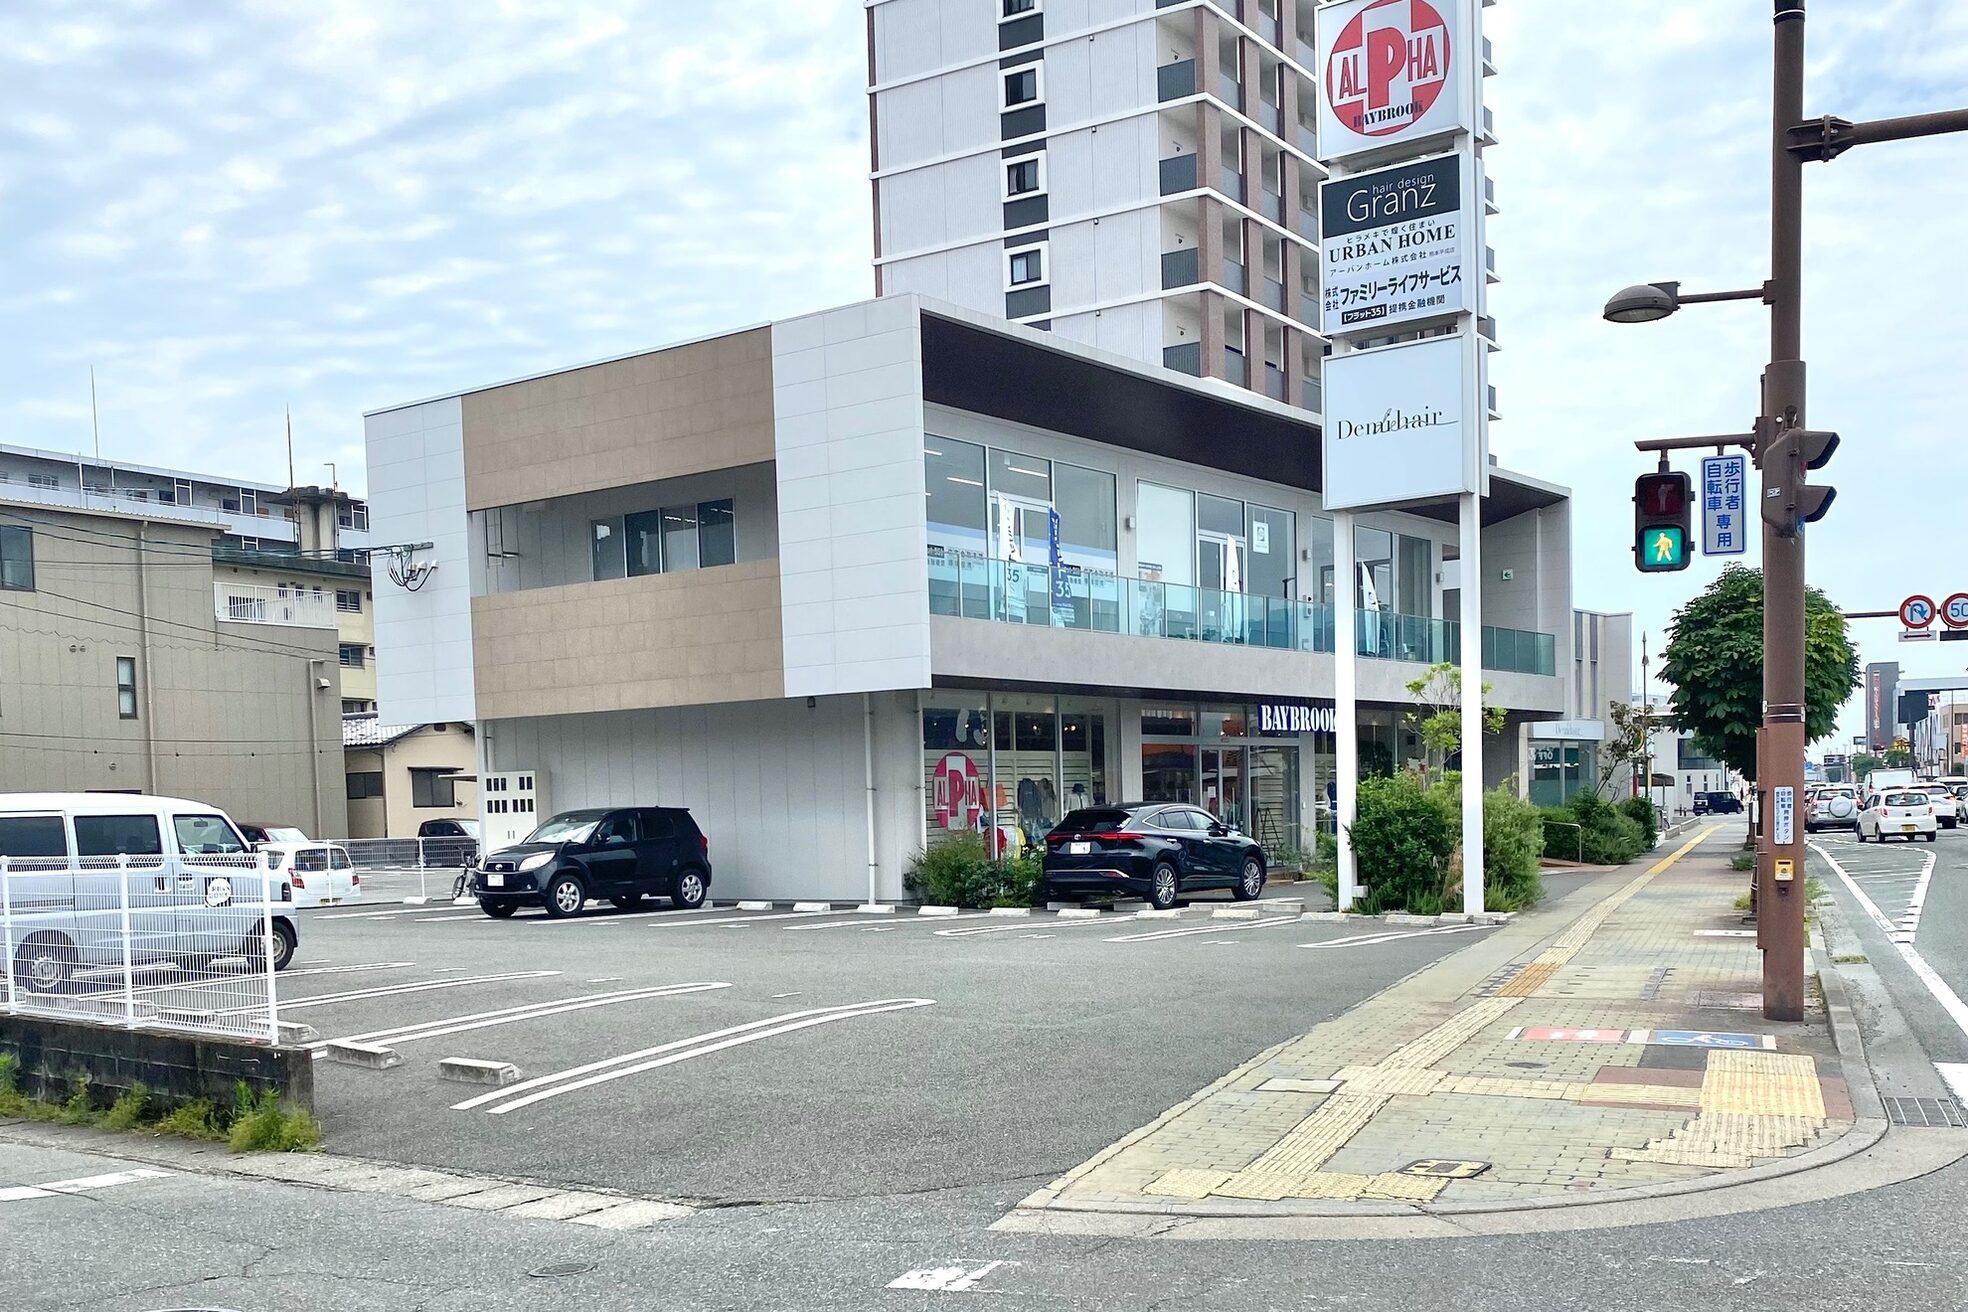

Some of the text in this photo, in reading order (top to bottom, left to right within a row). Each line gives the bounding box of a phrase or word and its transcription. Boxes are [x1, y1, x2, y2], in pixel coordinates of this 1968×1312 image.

[1339, 27, 1438, 110] ALPHA
[1353, 100, 1423, 128] BAYBROOK
[1347, 183, 1436, 222] Granz
[1373, 173, 1434, 195] hair design
[1329, 224, 1455, 263] URBAN HOME
[1330, 251, 1427, 277] アーバンホーム株式会社
[1325, 285, 1339, 298] 株式
[1340, 265, 1461, 305] ファミリーライフサービス
[1325, 299, 1339, 311] 会社
[1707, 463, 1722, 511] 自転車
[1724, 461, 1740, 510] 歩行者
[1716, 514, 1732, 548] 専用
[937, 769, 977, 817] ALPHA
